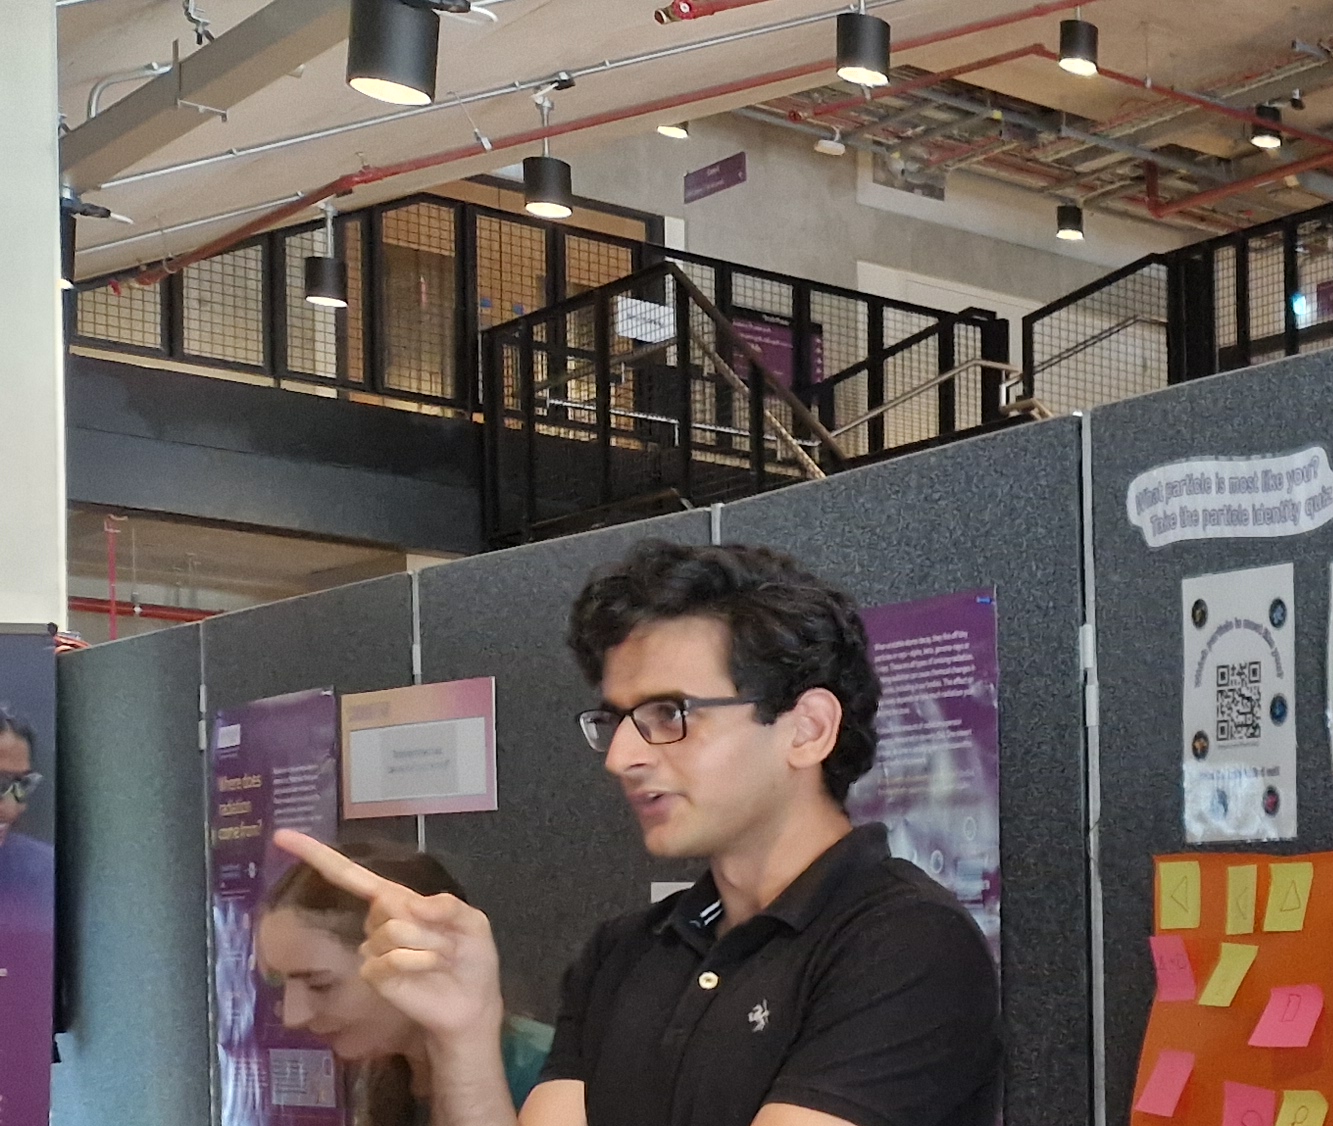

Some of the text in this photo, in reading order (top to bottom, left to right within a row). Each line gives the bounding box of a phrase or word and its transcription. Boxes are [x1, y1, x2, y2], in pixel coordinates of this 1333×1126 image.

[1165, 472, 1212, 505] particle
[1215, 471, 1226, 495] is
[1228, 471, 1259, 495] most
[1260, 469, 1285, 493] like
[1285, 454, 1320, 494] you?
[1149, 485, 1333, 537] Take the particle identity quiz
